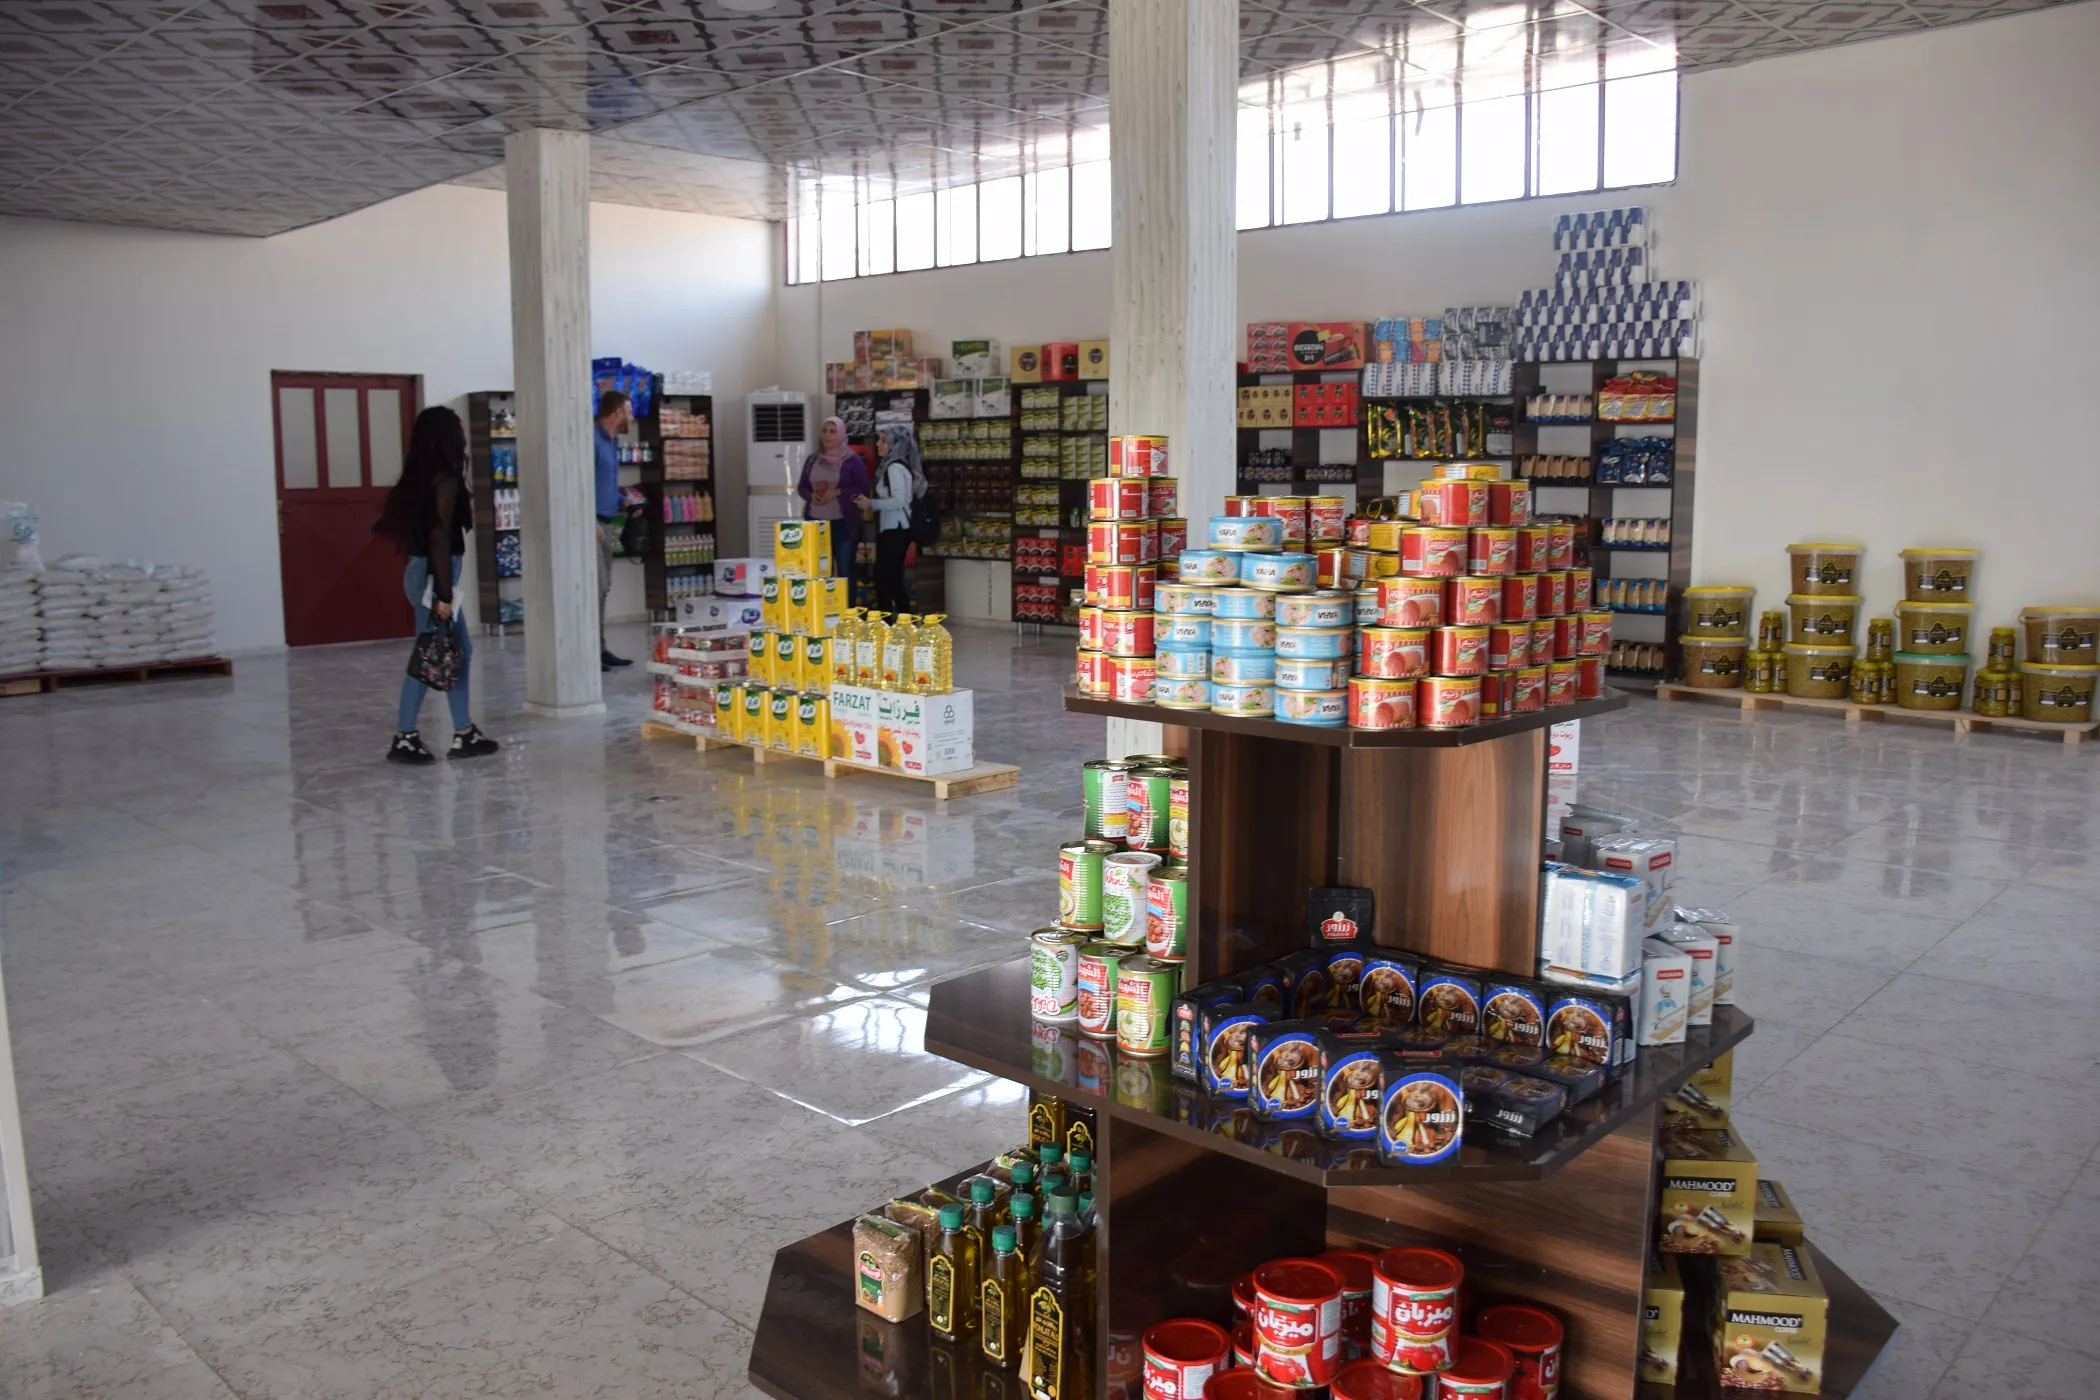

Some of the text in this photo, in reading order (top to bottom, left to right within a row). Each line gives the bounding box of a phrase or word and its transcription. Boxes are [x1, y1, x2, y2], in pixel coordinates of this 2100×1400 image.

[1218, 527, 1237, 537] YARA
[1256, 567, 1276, 577] YARA
[833, 691, 872, 711] FARZAT
[878, 697, 920, 721] فرزات
[1423, 1109, 1456, 1123] زرزور
[1669, 1179, 1732, 1192] MAHMOOD
[1394, 1298, 1453, 1328] ميزبان
[1731, 1312, 1798, 1328] MAHMOOD
